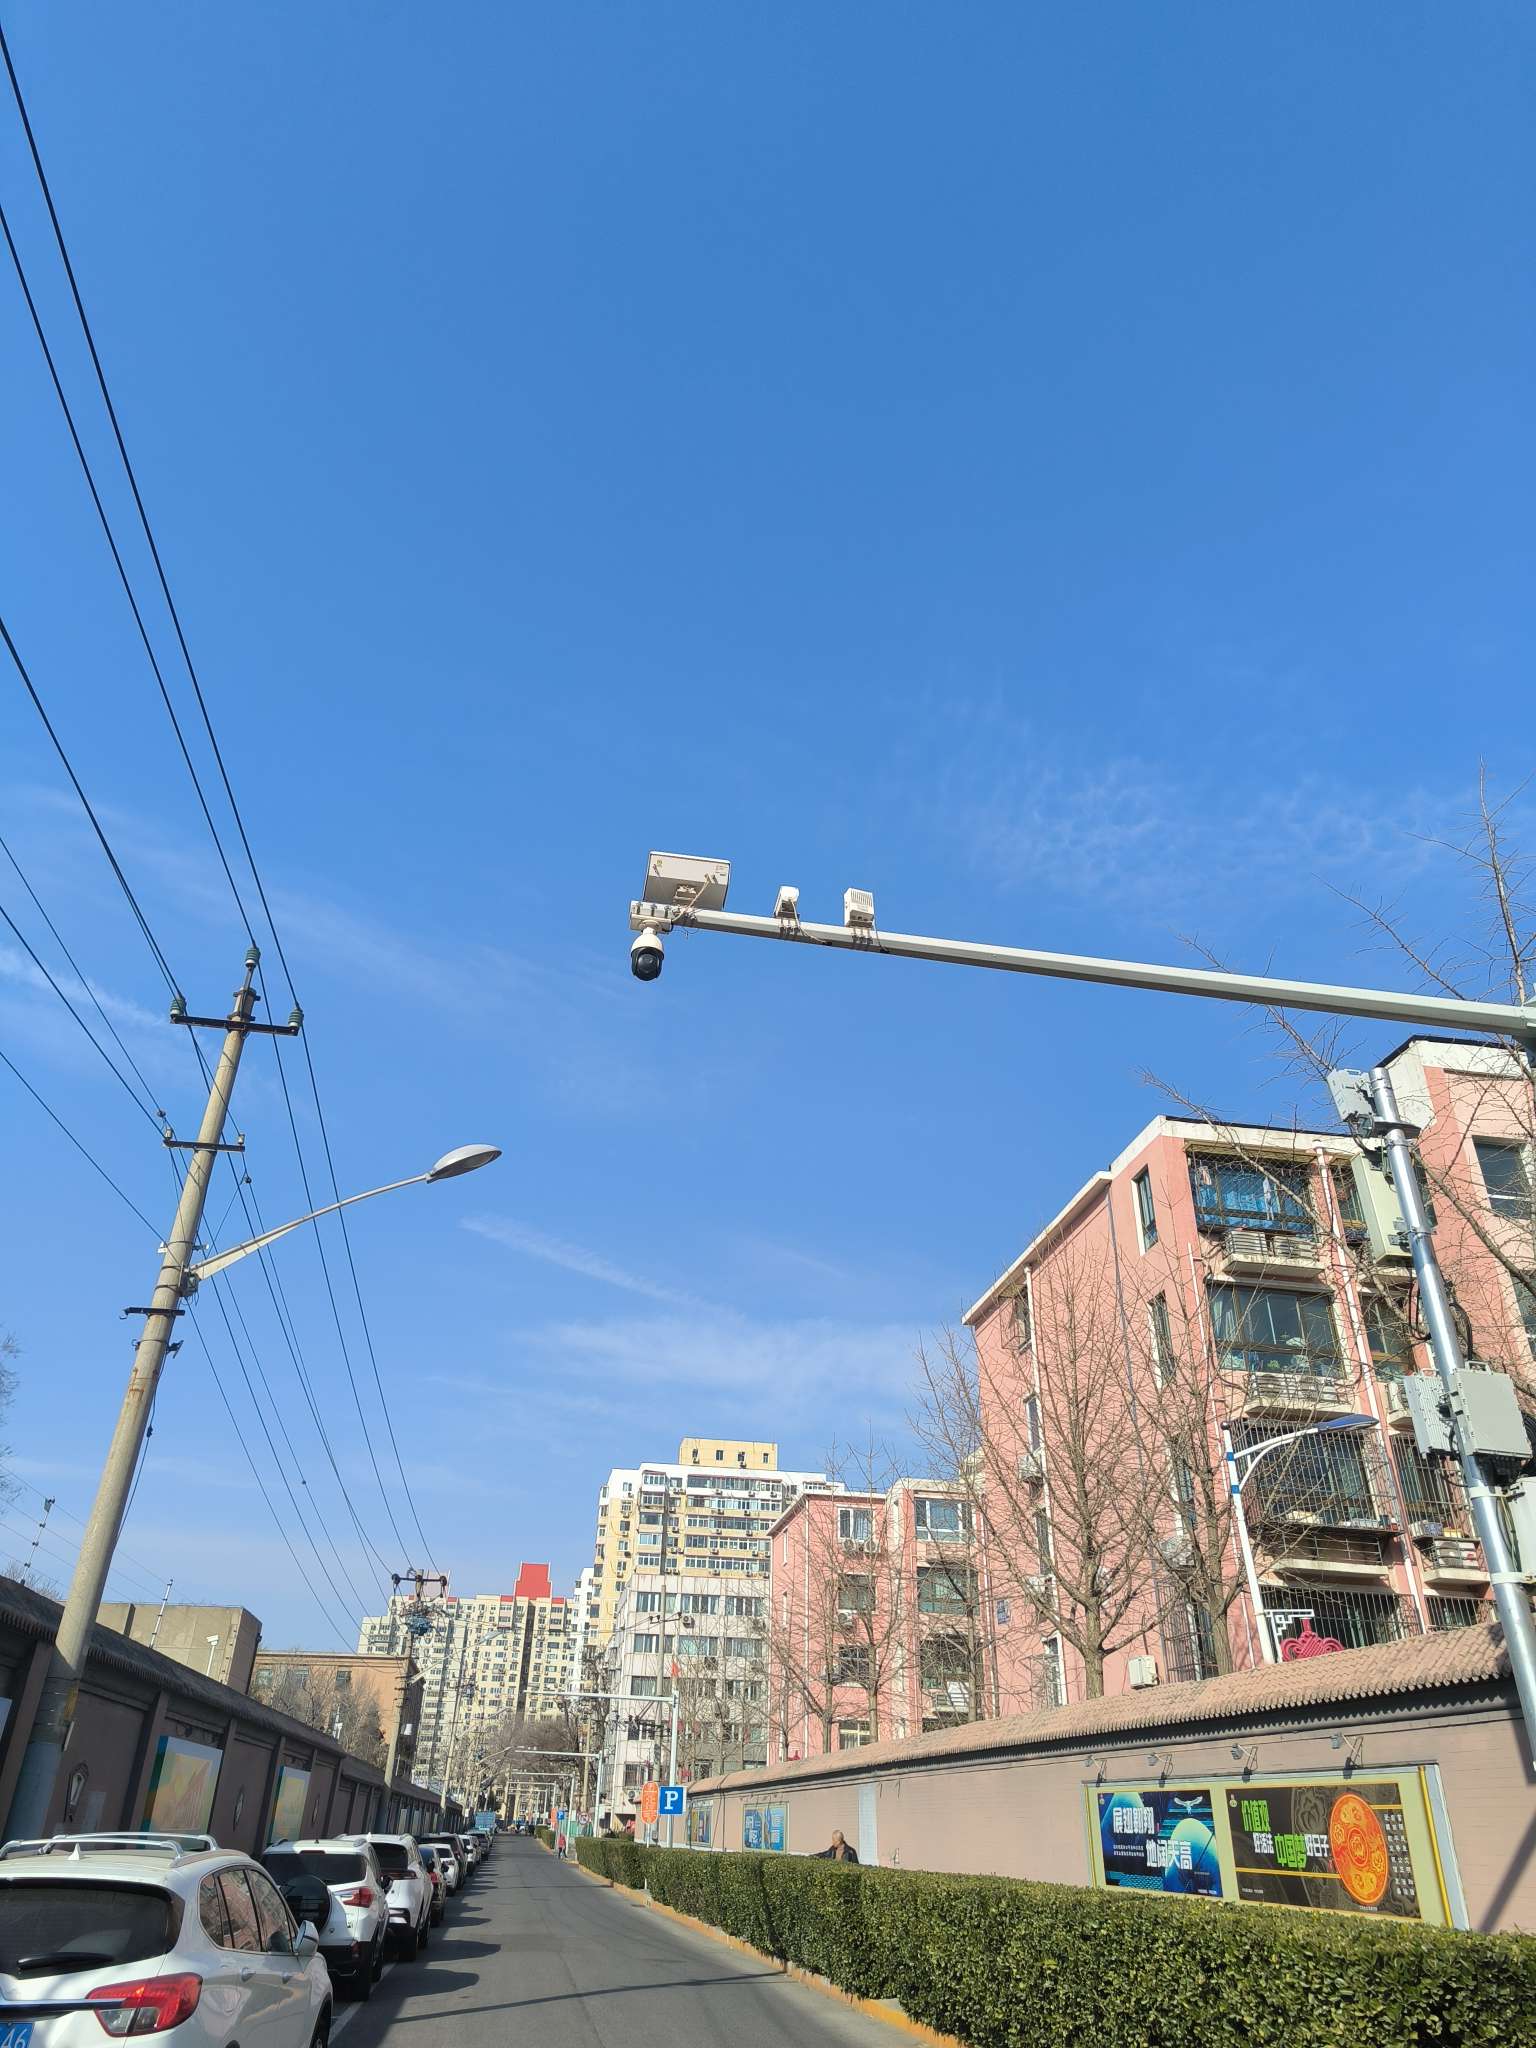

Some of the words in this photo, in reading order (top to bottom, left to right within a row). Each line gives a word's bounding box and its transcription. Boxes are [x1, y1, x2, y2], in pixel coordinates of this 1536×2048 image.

[664, 1790, 679, 1810] P
[1241, 1799, 1271, 1832] 价值观
[1274, 1832, 1307, 1868] 中国梦
[1304, 1833, 1329, 1857] 好日子
